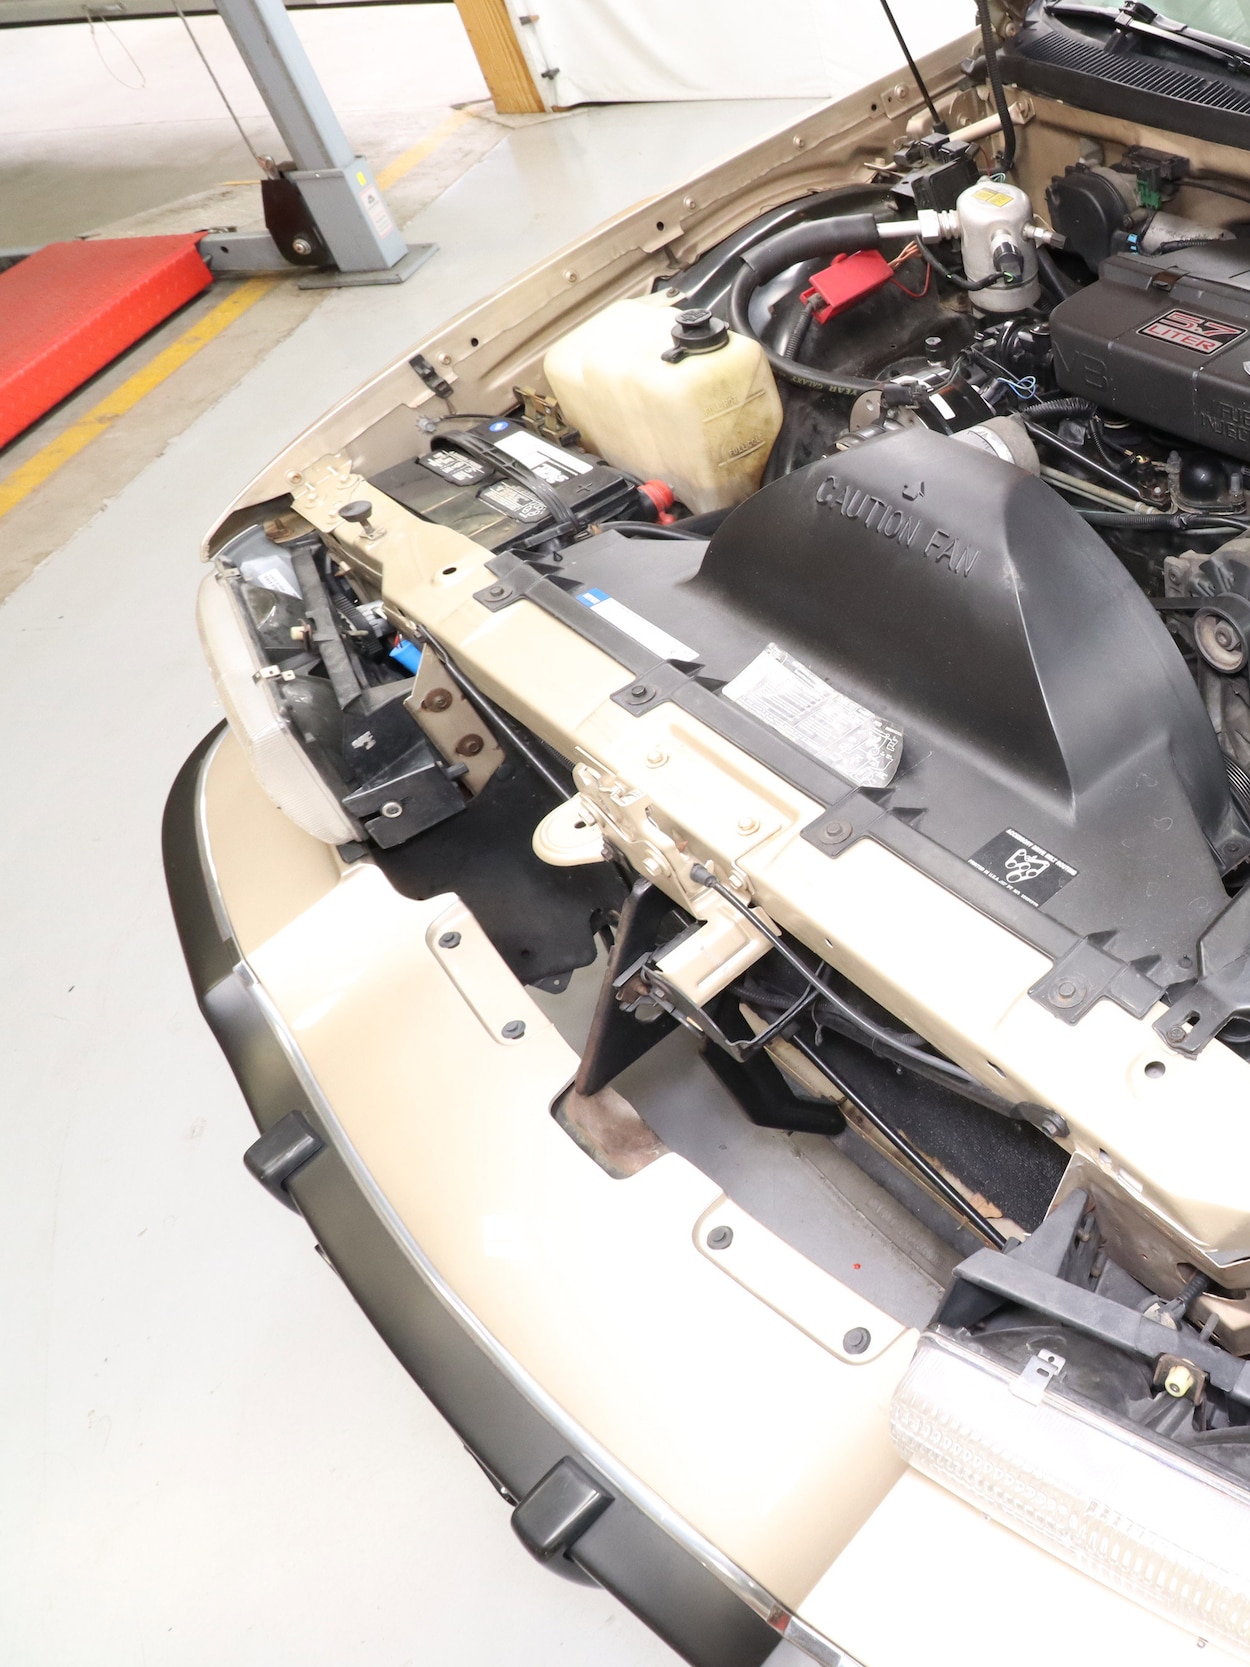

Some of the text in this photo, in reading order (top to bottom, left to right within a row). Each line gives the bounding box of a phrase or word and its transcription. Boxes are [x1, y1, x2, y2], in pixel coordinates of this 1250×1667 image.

[1159, 312, 1242, 336] 5.7
[1147, 324, 1216, 350] LITER
[816, 475, 980, 577] CAUTION FAN
[1044, 853, 1057, 863] BELT
